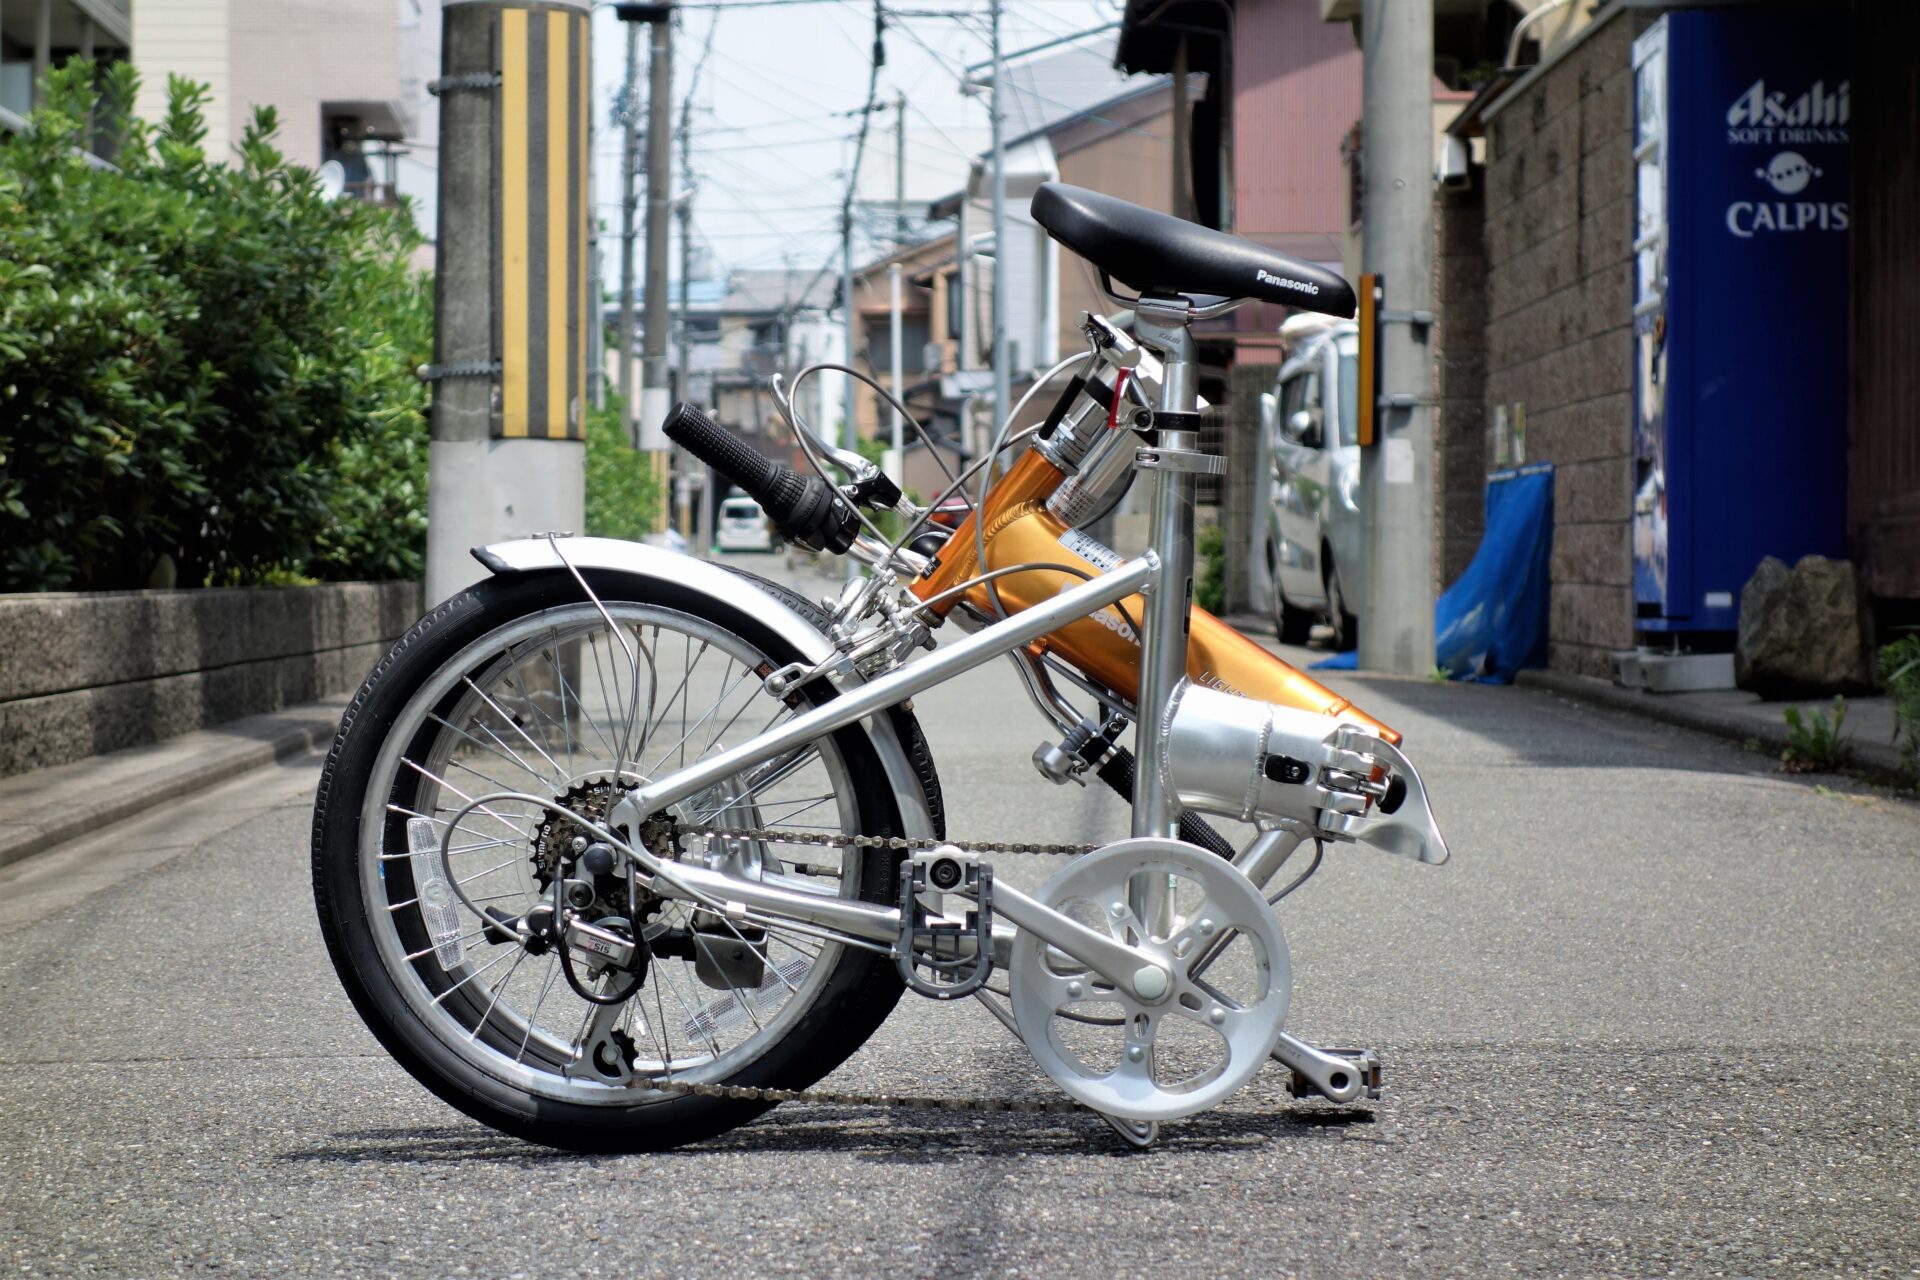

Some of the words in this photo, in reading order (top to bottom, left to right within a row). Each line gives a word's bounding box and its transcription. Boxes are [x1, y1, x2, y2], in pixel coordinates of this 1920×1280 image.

[1727, 79, 1850, 127] Asahi
[1728, 128, 1773, 144] SOFT
[1780, 128, 1850, 144] DRINKS
[1726, 201, 1849, 237] CALPIS
[1256, 269, 1319, 295] Panasonic
